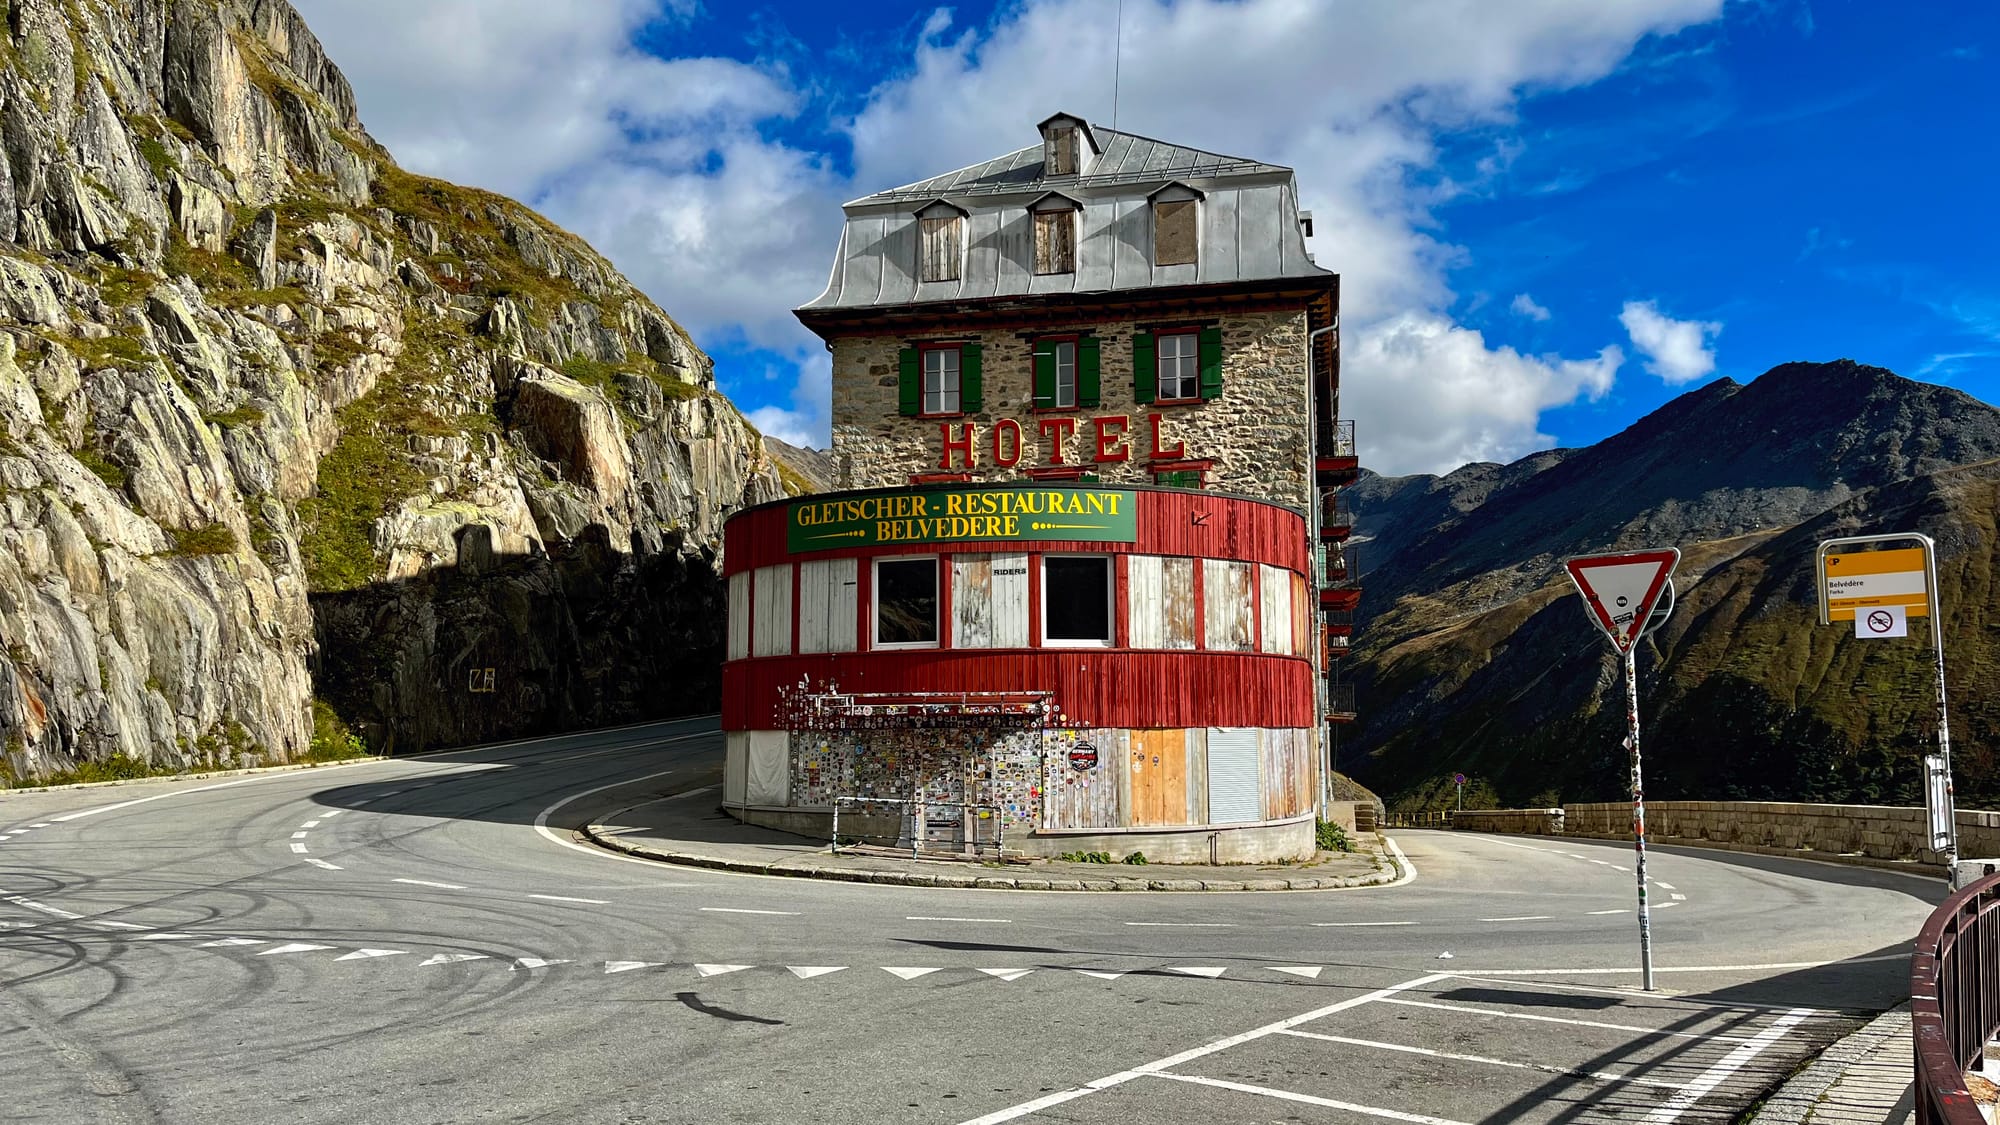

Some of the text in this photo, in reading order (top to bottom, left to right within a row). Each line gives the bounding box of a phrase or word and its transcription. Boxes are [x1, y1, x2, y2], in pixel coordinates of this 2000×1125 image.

[939, 413, 1186, 469] HOTEL
[797, 495, 927, 526] GLETSCHER
[946, 492, 1123, 516] RESTAURANT
[875, 515, 1021, 542] BELVEDERE
[993, 568, 1027, 576] RIDERS
[1829, 580, 1864, 588] Belvédère
